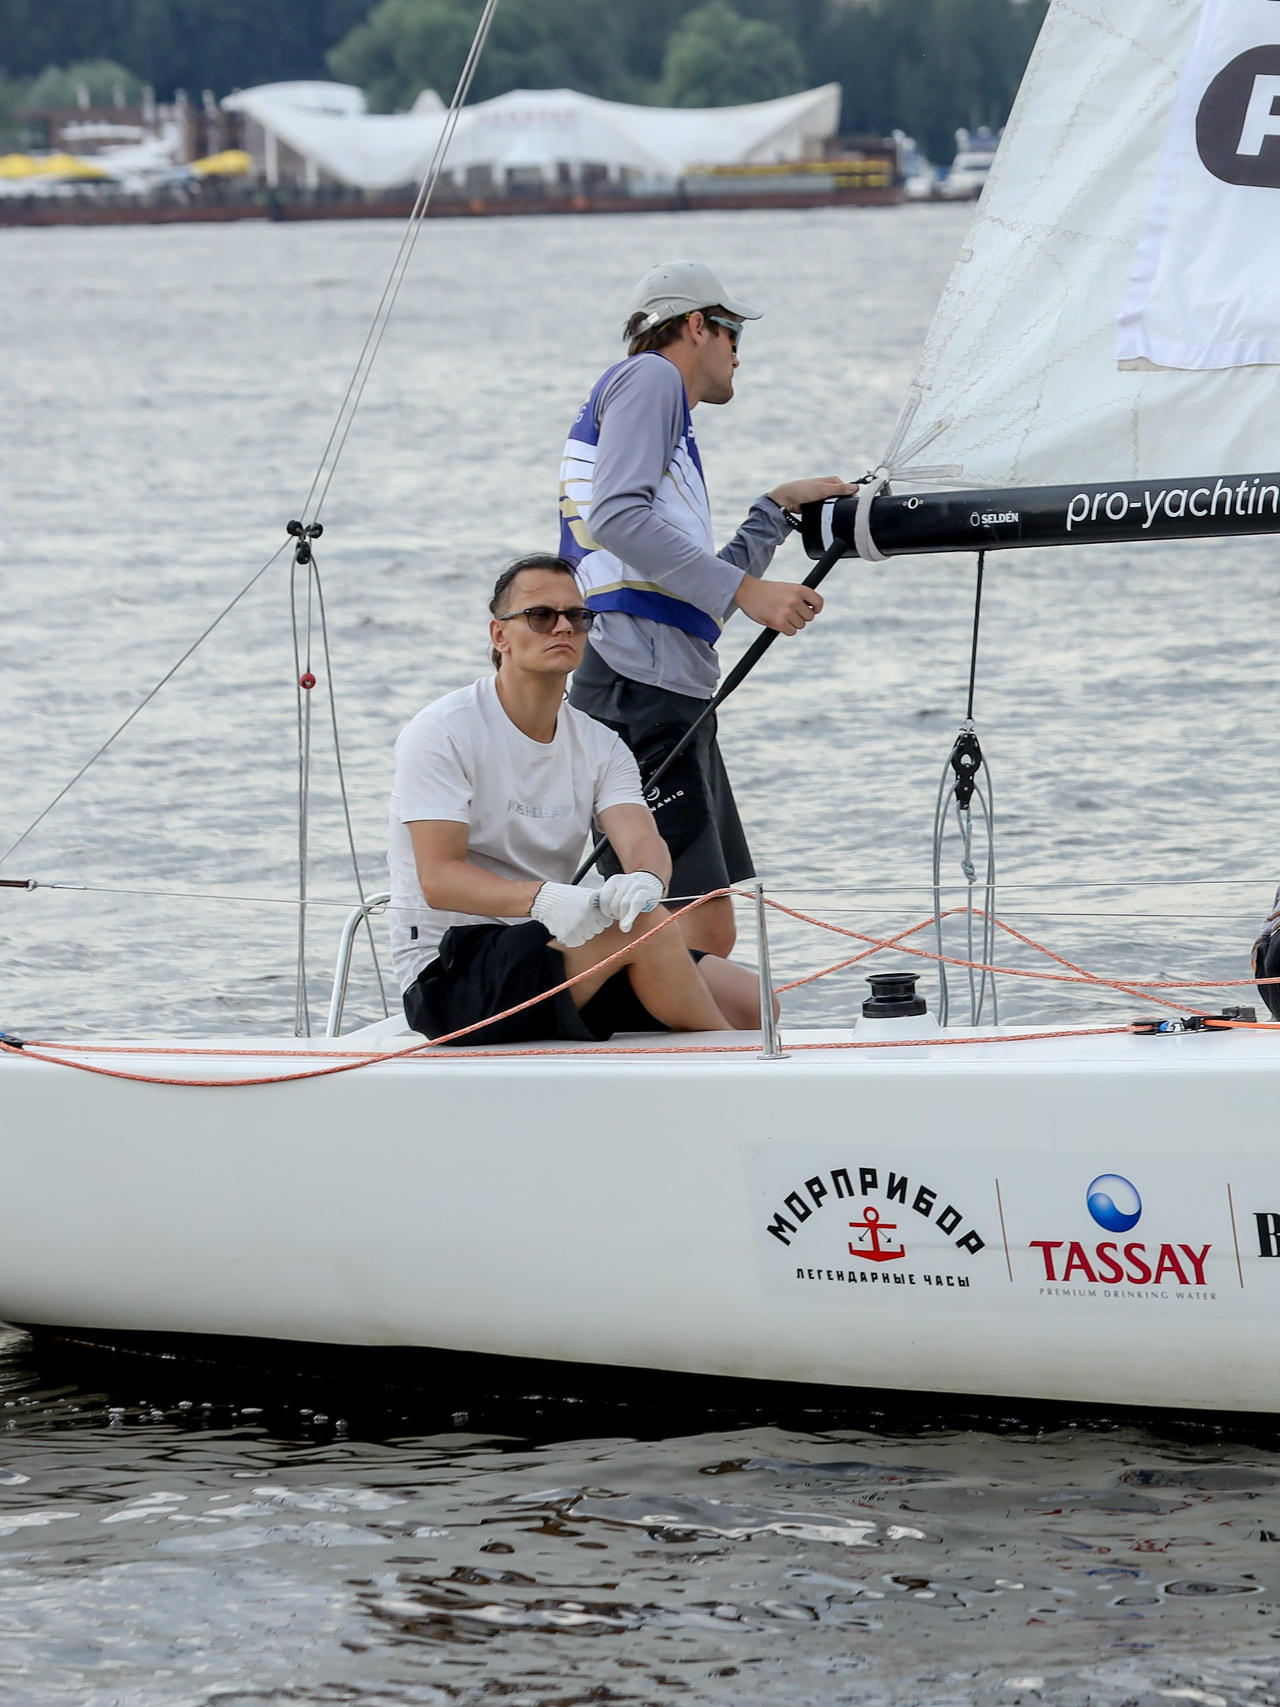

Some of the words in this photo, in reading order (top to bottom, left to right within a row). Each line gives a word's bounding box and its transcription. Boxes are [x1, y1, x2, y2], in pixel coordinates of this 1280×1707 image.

[981, 510, 1019, 525] SELDÉN
[767, 1167, 986, 1255] МОРПРИБОР
[1029, 1241, 1213, 1286] TASSAY
[796, 1268, 916, 1285] ЛЕГЕНДАРНЫЕ
[923, 1274, 970, 1288] ЧАСЫ
[1039, 1287, 1098, 1298] PREMIUM
[1104, 1289, 1169, 1300] DRINKING
[1175, 1291, 1217, 1301] WATER
